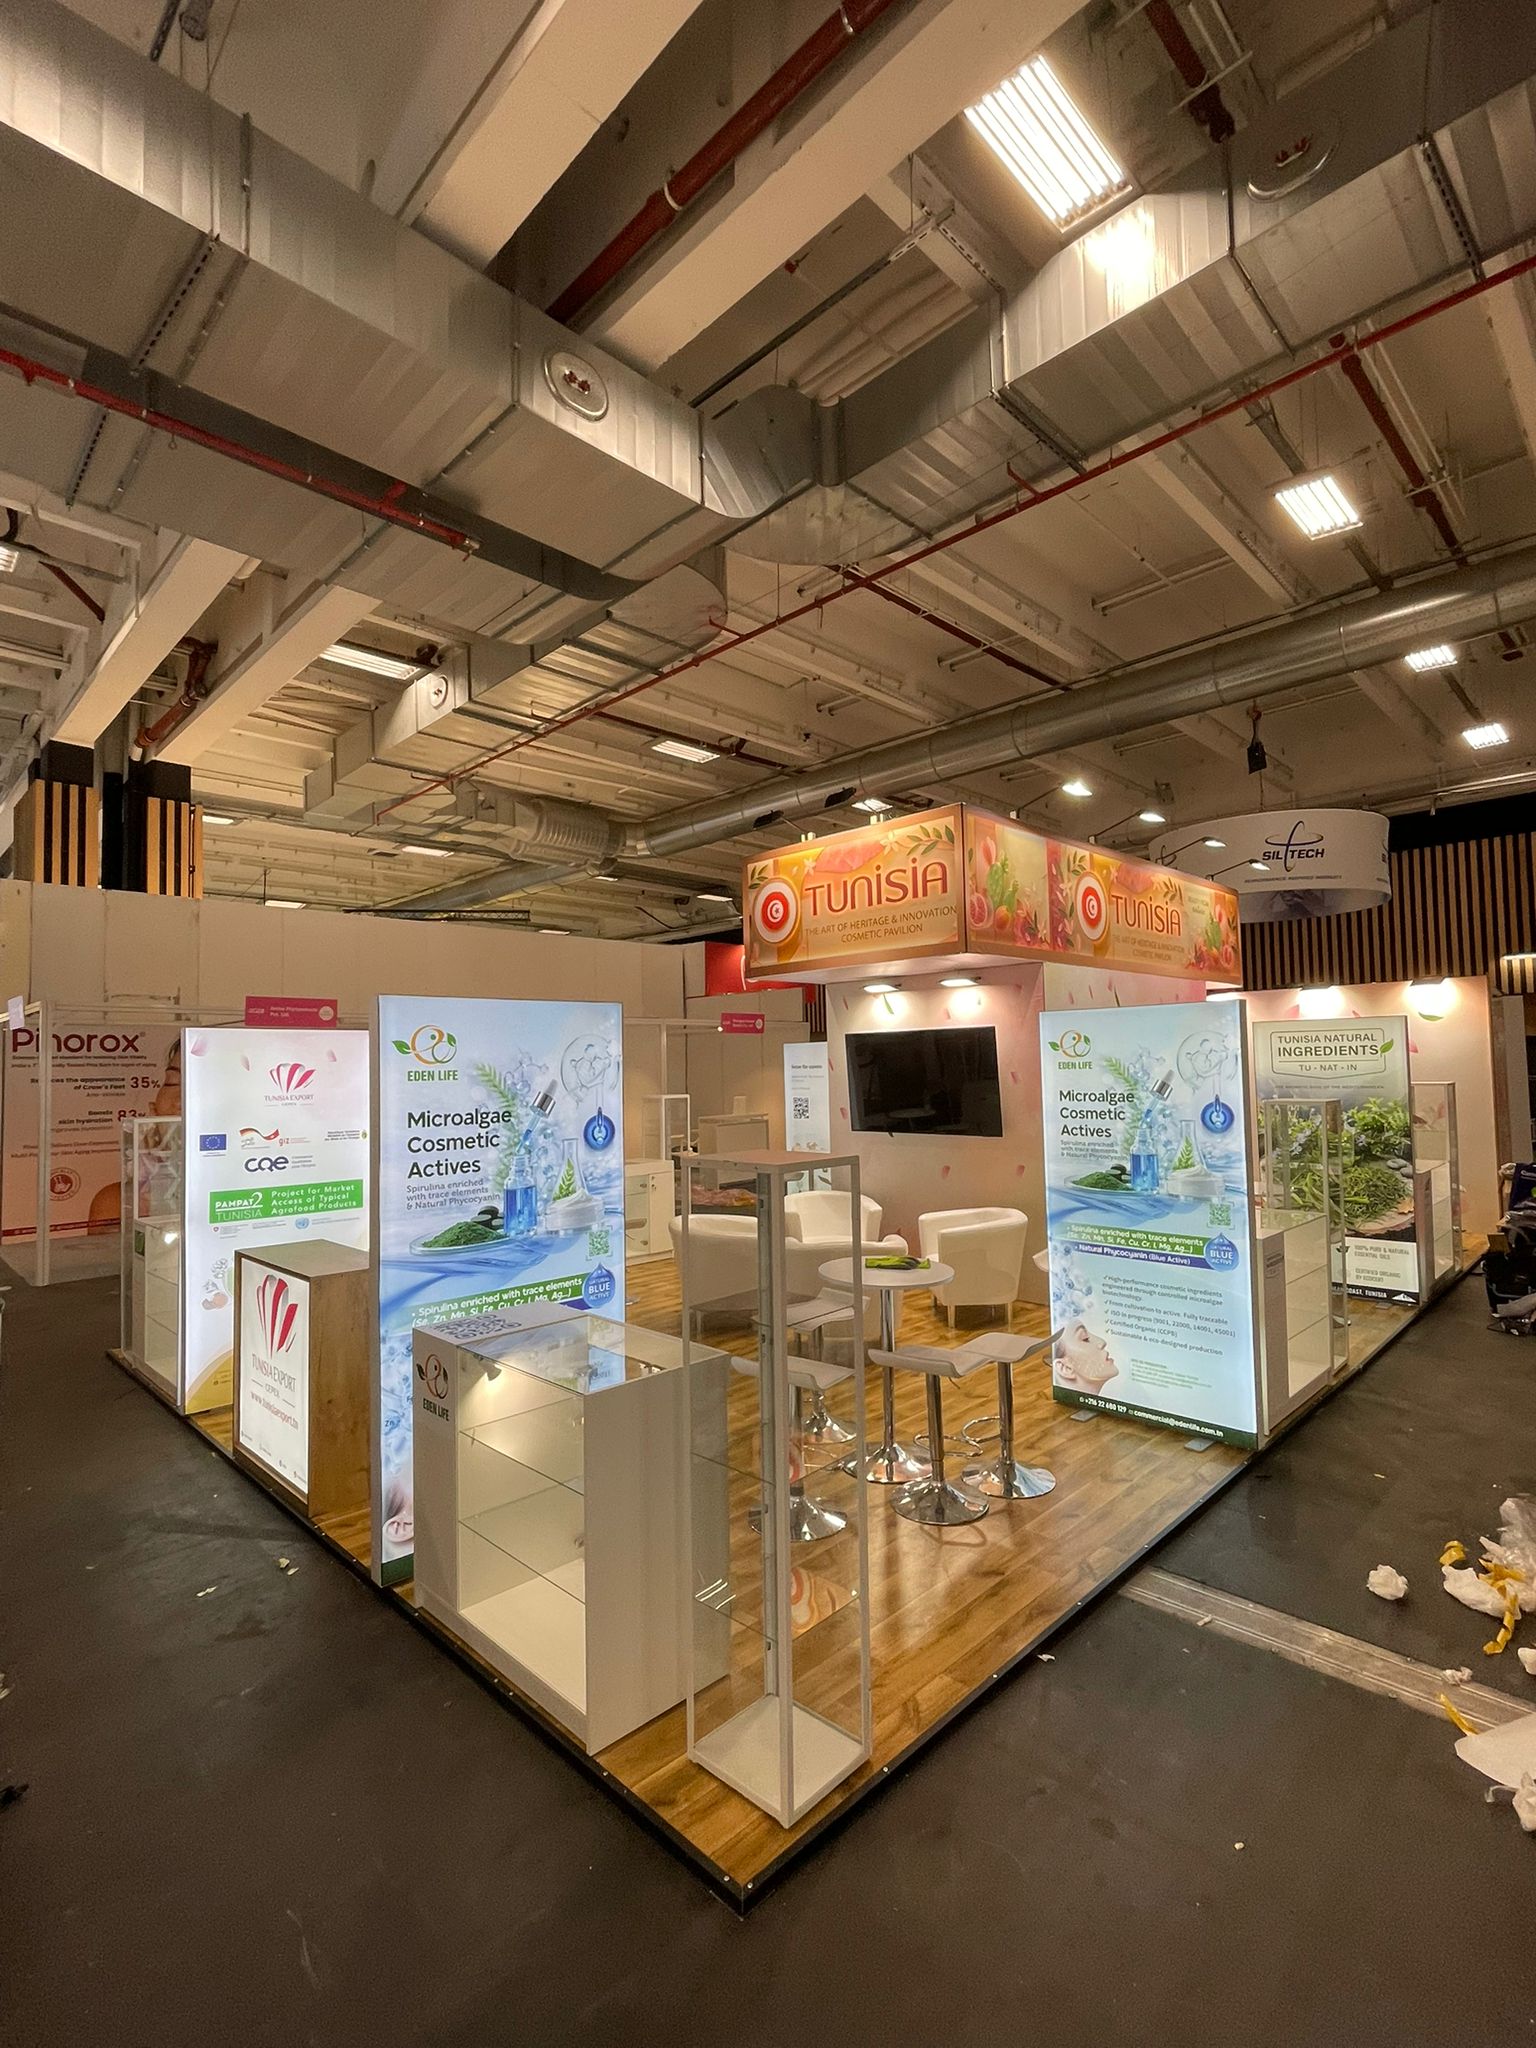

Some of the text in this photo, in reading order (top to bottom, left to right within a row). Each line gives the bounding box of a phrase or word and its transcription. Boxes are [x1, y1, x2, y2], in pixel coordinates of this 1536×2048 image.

[806, 905, 957, 936] THE ART OF HERITAGE & INNOVATION
[841, 924, 923, 943] COSMETIC PAVILION
[1278, 1033, 1377, 1044] TUNISIA NATURAL
[1278, 1045, 1379, 1057] INGREDIENTS
[1078, 1061, 1093, 1069] LIFE
[407, 1070, 458, 1082] EDEN LIFE
[1059, 1090, 1135, 1106] Microalgae
[407, 1108, 512, 1129] Microalgae
[1060, 1107, 1126, 1120] Cosmetic
[1061, 1124, 1112, 1137] Actives
[407, 1132, 500, 1153] Cosmetic
[408, 1158, 481, 1179] Actives
[271, 1190, 304, 1198] Project
[324, 1185, 355, 1193] Market
[407, 1178, 484, 1194] Spirulina enriched
[271, 1198, 302, 1206] Access
[320, 1193, 349, 1203] Typical
[407, 1187, 488, 1201] with trace elements
[271, 1200, 357, 1216] Agrofood Products
[415, 1199, 446, 1209] Natural
[449, 1194, 500, 1206] Phycocyanin
[215, 1209, 263, 1222] TUNISIA
[1071, 1225, 1203, 1247] Spirulina enriched with trace elements
[1079, 1244, 1190, 1265] Natural Phycocyanin (Blue Active)
[1210, 1251, 1233, 1260] BLUE
[588, 1284, 610, 1293] BLUE
[1160, 1284, 1186, 1293] cosmetic
[1187, 1287, 1222, 1298] ingredients
[1365, 1289, 1387, 1298] TUNISIA
[418, 1277, 582, 1317] Spirulina enriched with trace elements
[1134, 1287, 1157, 1296] through
[1157, 1291, 1188, 1300] controlled
[1189, 1295, 1223, 1306] microalgae
[1124, 1303, 1154, 1313] cultivation
[1183, 1312, 1198, 1321] Fully
[1199, 1315, 1228, 1325] traceable
[1128, 1313, 1152, 1323] progress
[1110, 1319, 1133, 1329] Certified
[1135, 1323, 1156, 1333] Organic
[1110, 1329, 1142, 1341] Sustainable
[1149, 1337, 1188, 1349] eco-designed
[1189, 1344, 1223, 1356] production
[252, 1353, 273, 1378] TUNISIA
[273, 1366, 296, 1392] EXPORT
[423, 1398, 449, 1421] EDEN LIFE
[1098, 1400, 1105, 1408] 22
[1117, 1404, 1127, 1413] 129
